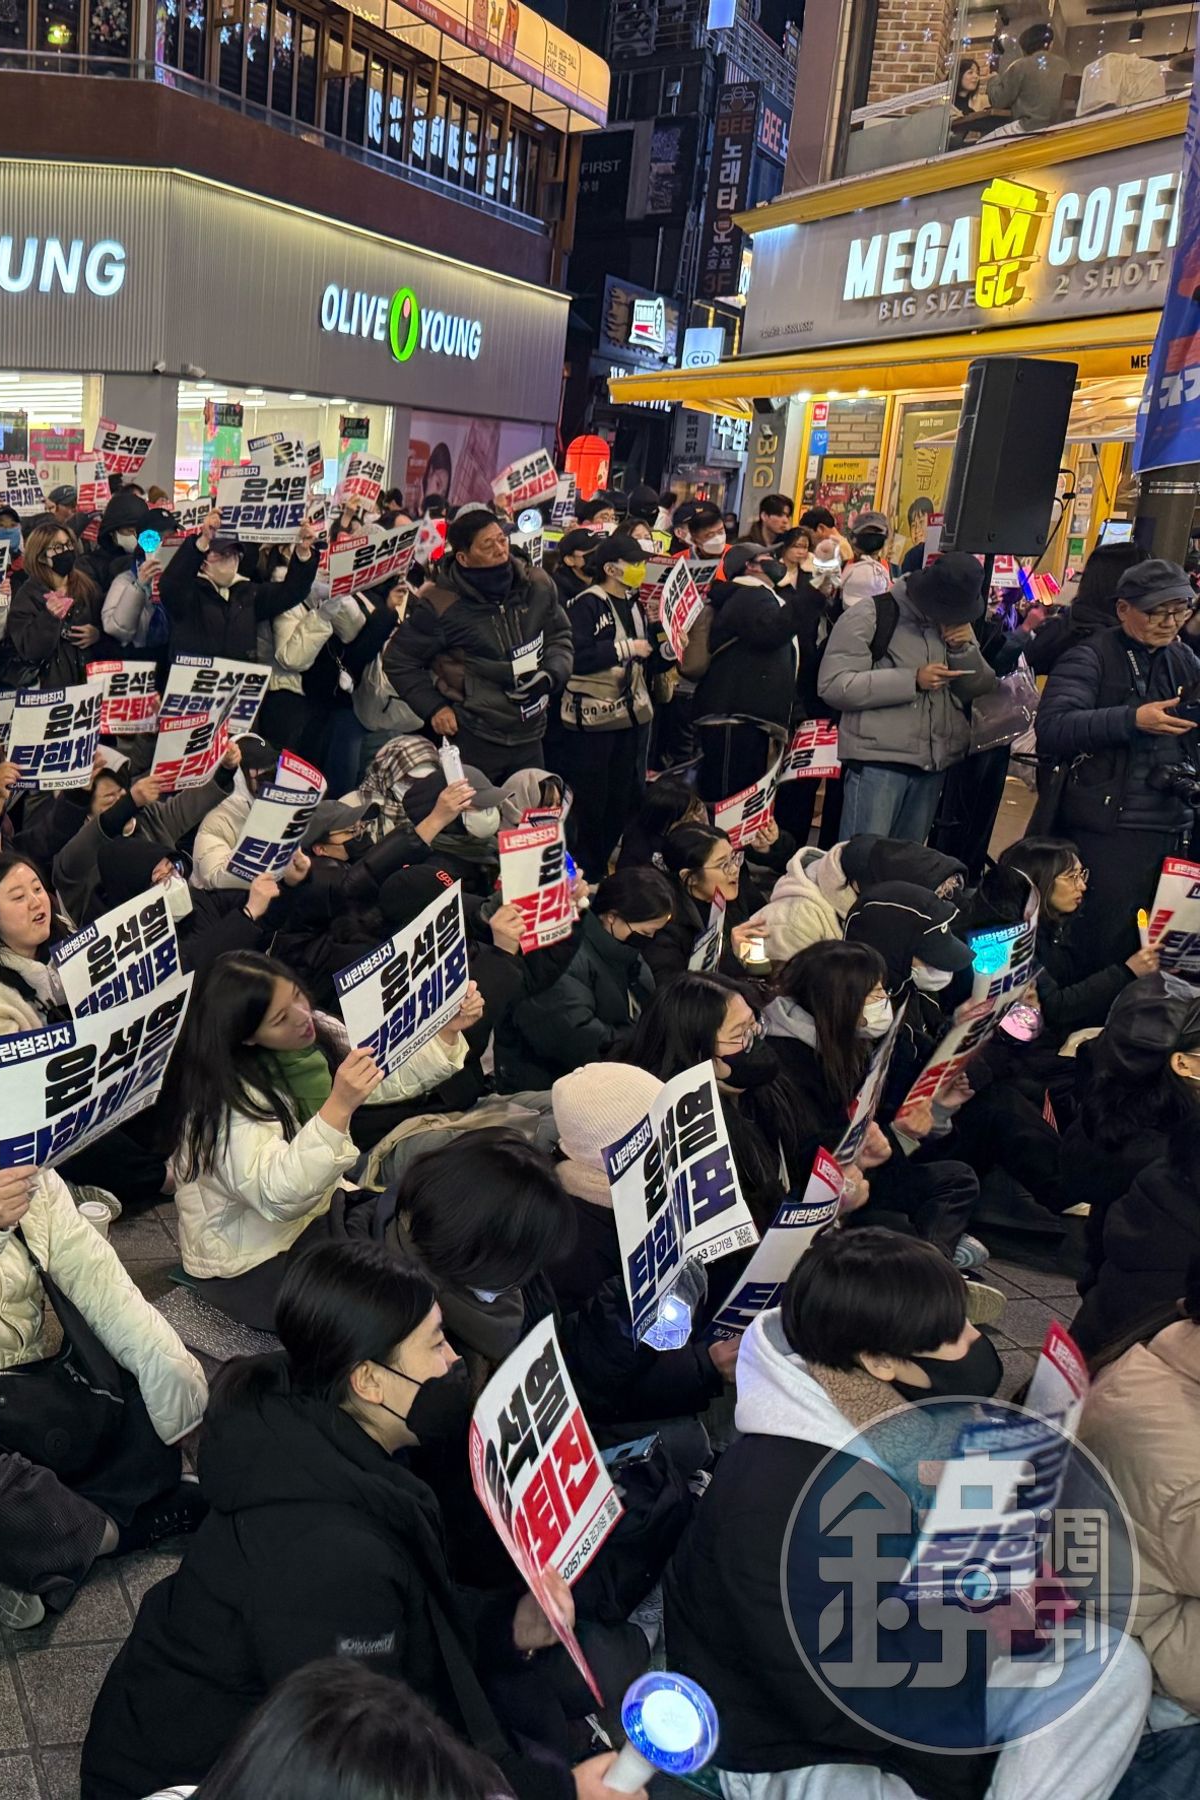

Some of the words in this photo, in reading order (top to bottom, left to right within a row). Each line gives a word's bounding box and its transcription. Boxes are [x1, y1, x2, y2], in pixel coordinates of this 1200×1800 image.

[717, 116, 753, 135] BEE
[762, 107, 782, 153] BEE
[581, 159, 622, 175] FIRST
[843, 216, 976, 301] MEGA
[1048, 170, 1185, 267] COFF
[1055, 274, 1071, 296] 2
[1082, 261, 1166, 291] SHOT
[321, 283, 388, 342] OLIVE
[419, 309, 482, 361] YOUNG
[879, 299, 917, 321] BIG
[925, 288, 976, 314] SIZE
[691, 352, 711, 366] CU
[100, 430, 154, 457] 윤석열
[753, 435, 779, 488] BIG
[240, 476, 308, 504] 윤석열
[219, 502, 307, 531] 탄핵체포
[18, 691, 66, 707] 내란범죄자
[190, 669, 267, 696] 윤석열
[162, 714, 209, 732] 내란범죄자
[263, 787, 318, 805] 내란범죄자
[55, 926, 97, 963] 내란범죄자
[86, 898, 170, 988] 윤석열
[379, 893, 461, 1017] 윤석열
[74, 934, 178, 1019] 탄핵체포
[338, 940, 393, 993] 내란범죄자
[45, 989, 189, 1119] 윤석열
[609, 1119, 652, 1176] 내란범죄자
[643, 1080, 719, 1225] 윤석열
[708, 1236, 734, 1257] 김기영
[514, 1405, 602, 1571] 퇴진
